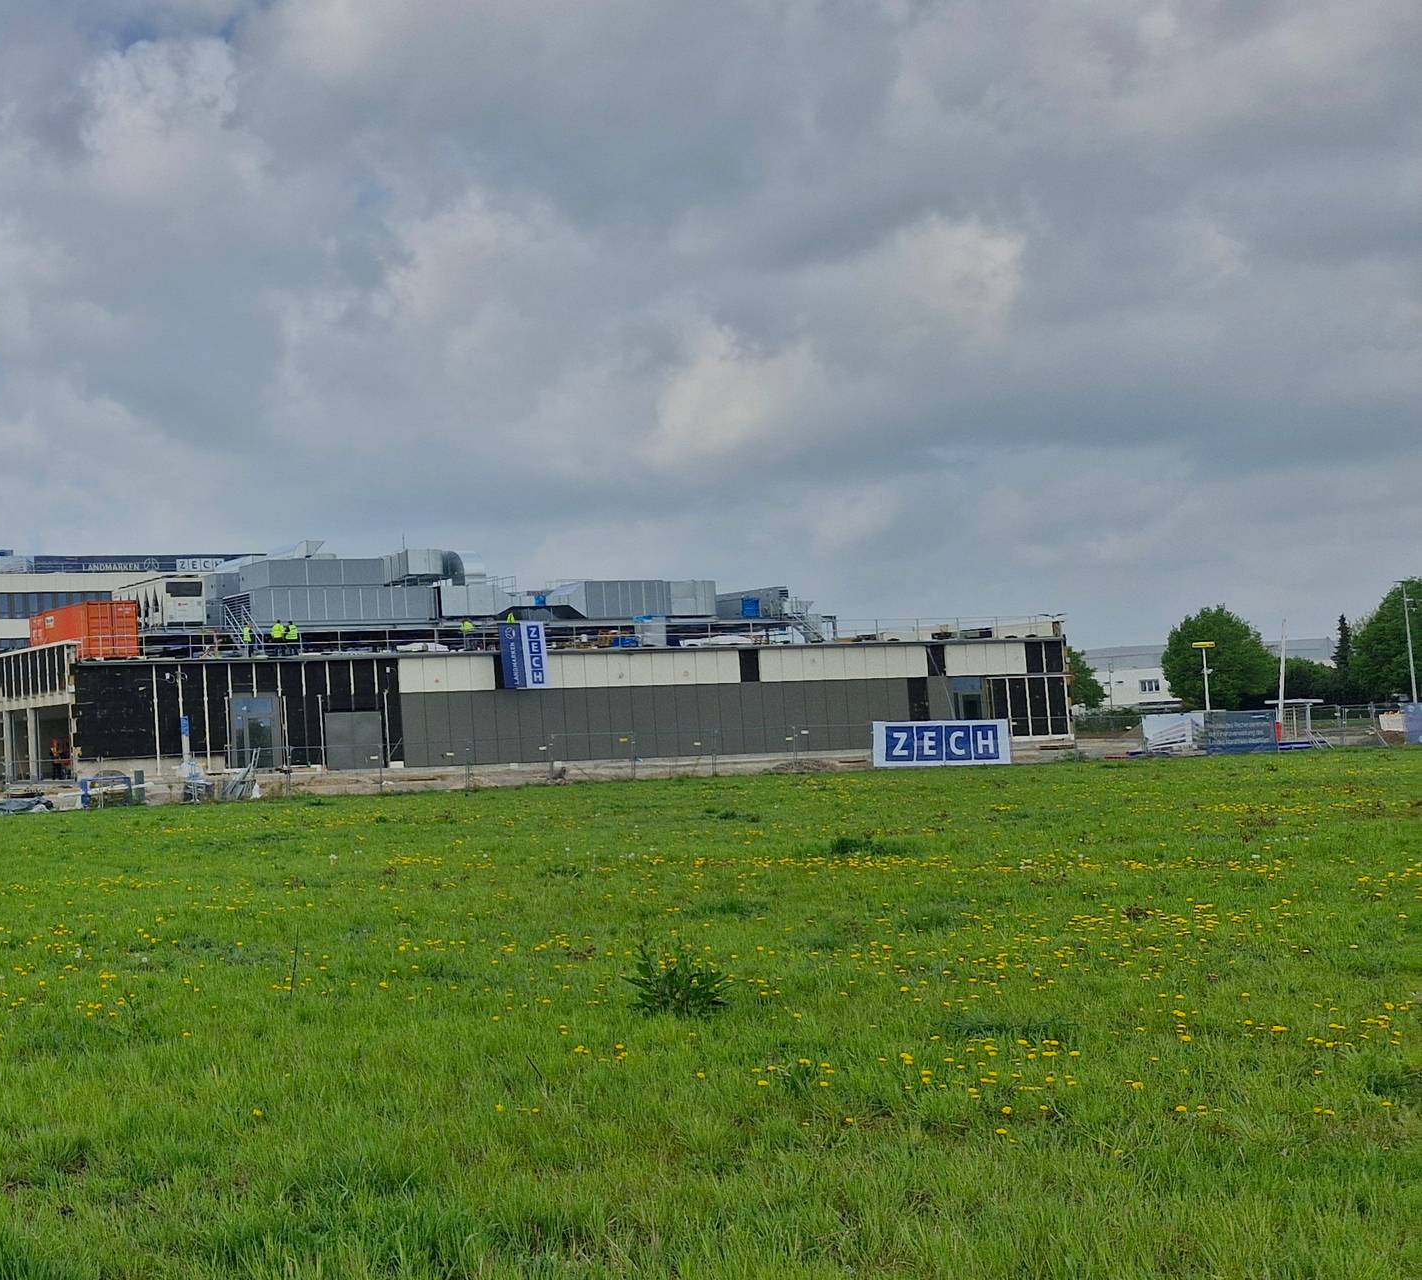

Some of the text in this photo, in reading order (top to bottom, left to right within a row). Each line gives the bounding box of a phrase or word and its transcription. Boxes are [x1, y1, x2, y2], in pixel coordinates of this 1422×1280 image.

[82, 562, 140, 572] LANDMARKEN
[509, 642, 520, 685] LANDMARKEN
[528, 627, 543, 682] ZECH
[892, 730, 995, 756] ZECH
